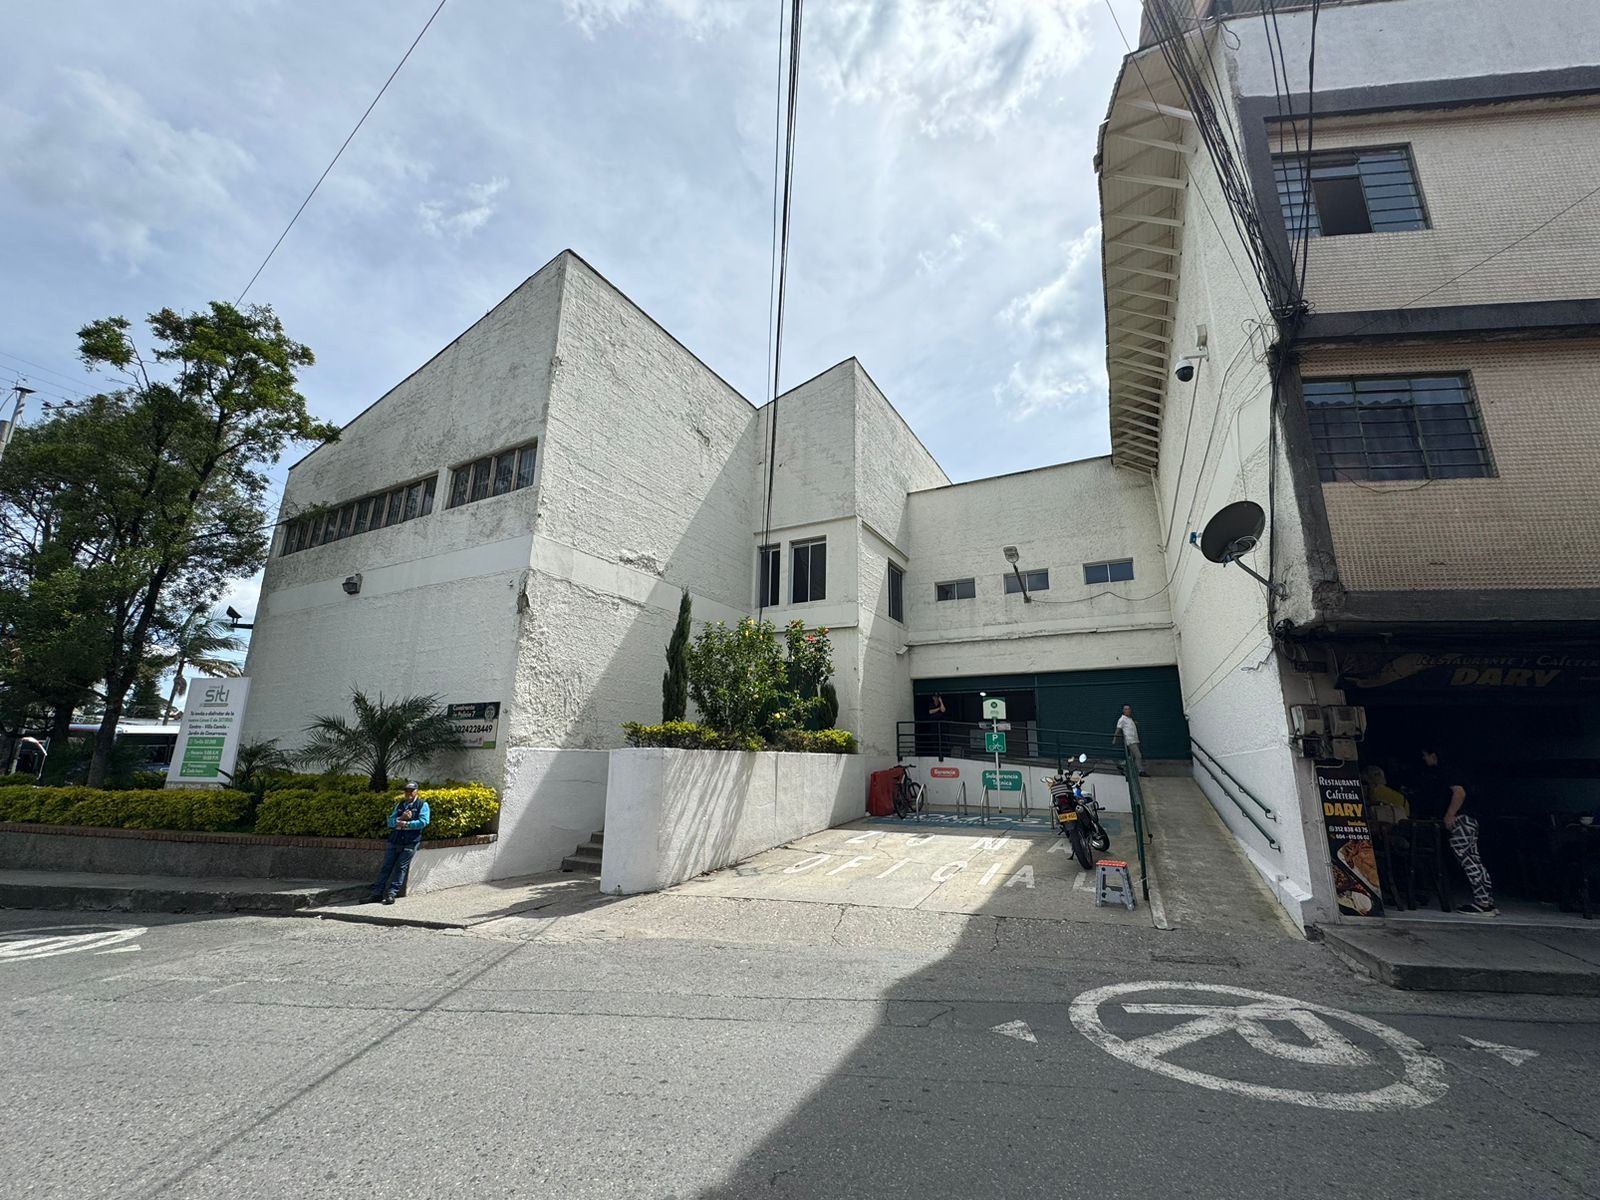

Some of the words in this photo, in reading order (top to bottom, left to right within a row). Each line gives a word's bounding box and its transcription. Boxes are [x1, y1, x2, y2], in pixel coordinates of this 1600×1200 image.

[1451, 668, 1560, 687] DARY
[1323, 802, 1363, 817] DARY
[844, 830, 1075, 853] ZONA
[783, 853, 1097, 892] OFICIAL
